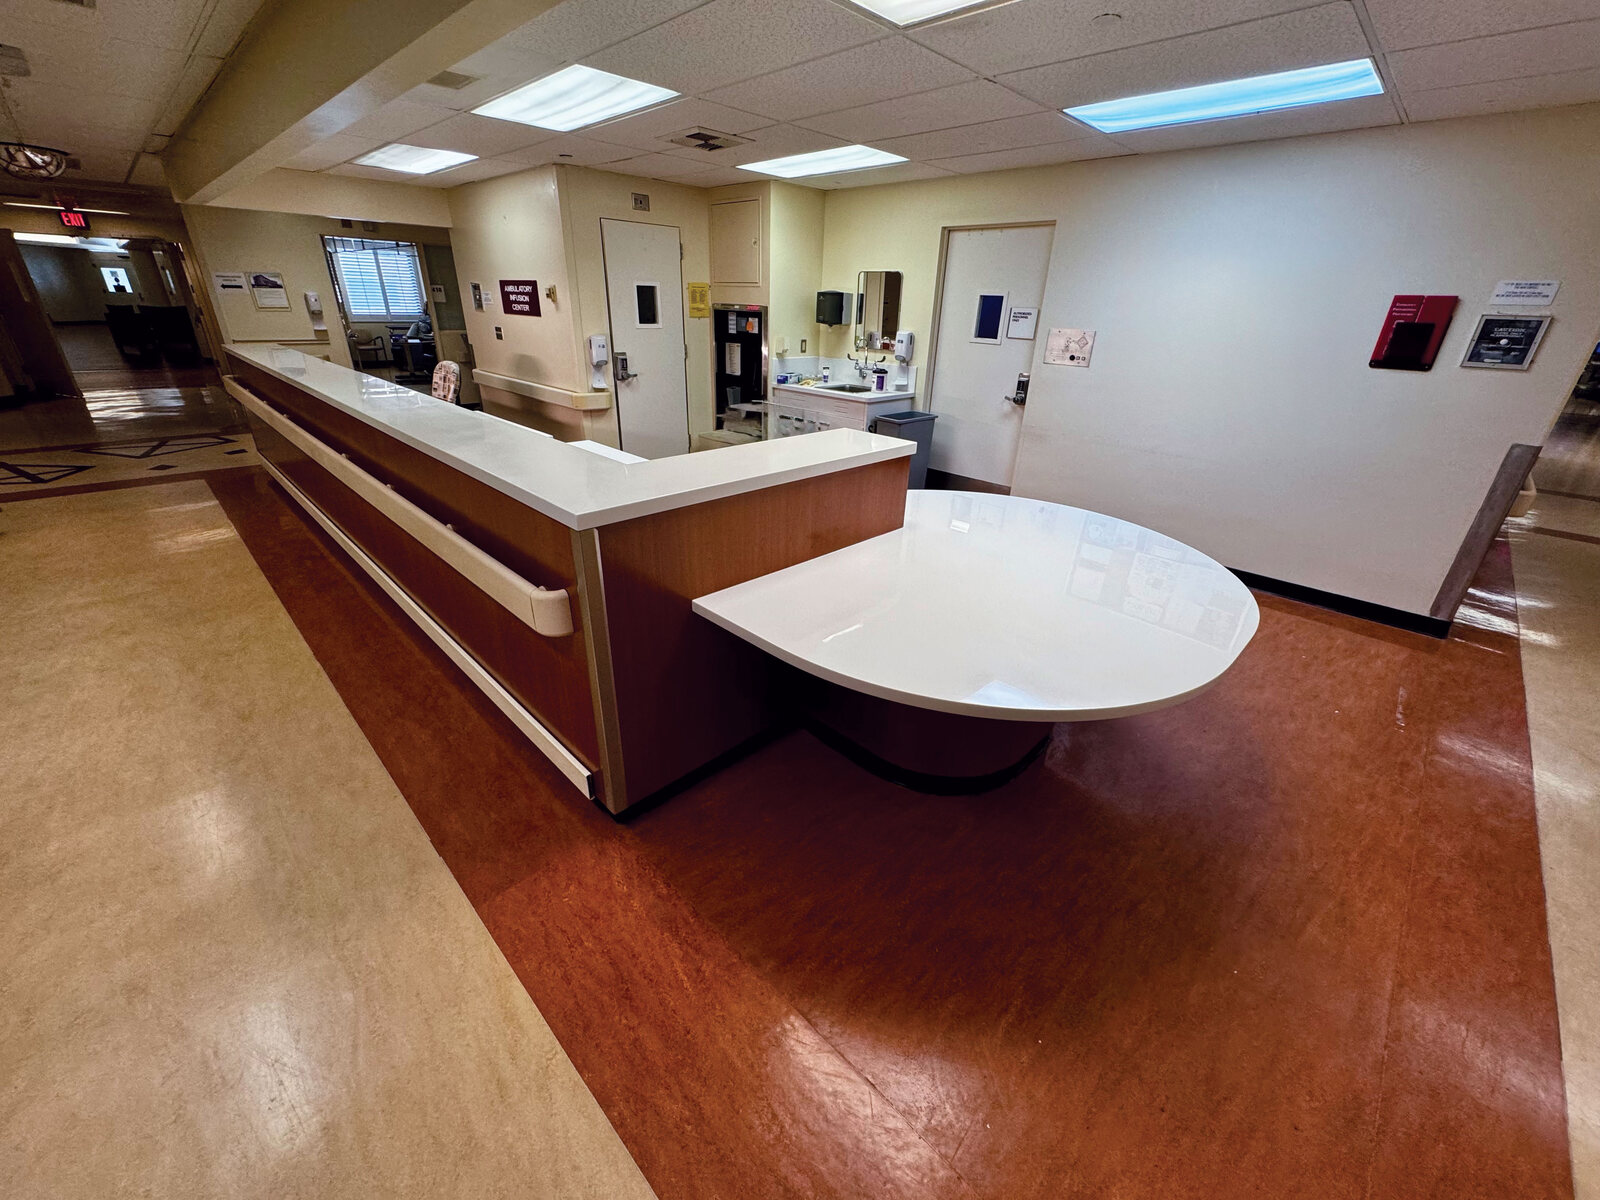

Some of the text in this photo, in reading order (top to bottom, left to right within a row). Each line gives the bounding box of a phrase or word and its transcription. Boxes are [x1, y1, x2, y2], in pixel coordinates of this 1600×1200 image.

[60, 212, 86, 228] EXIT
[505, 285, 532, 293] AMBULATORY
[509, 294, 529, 302] INFUSION
[511, 304, 530, 312] CENTER
